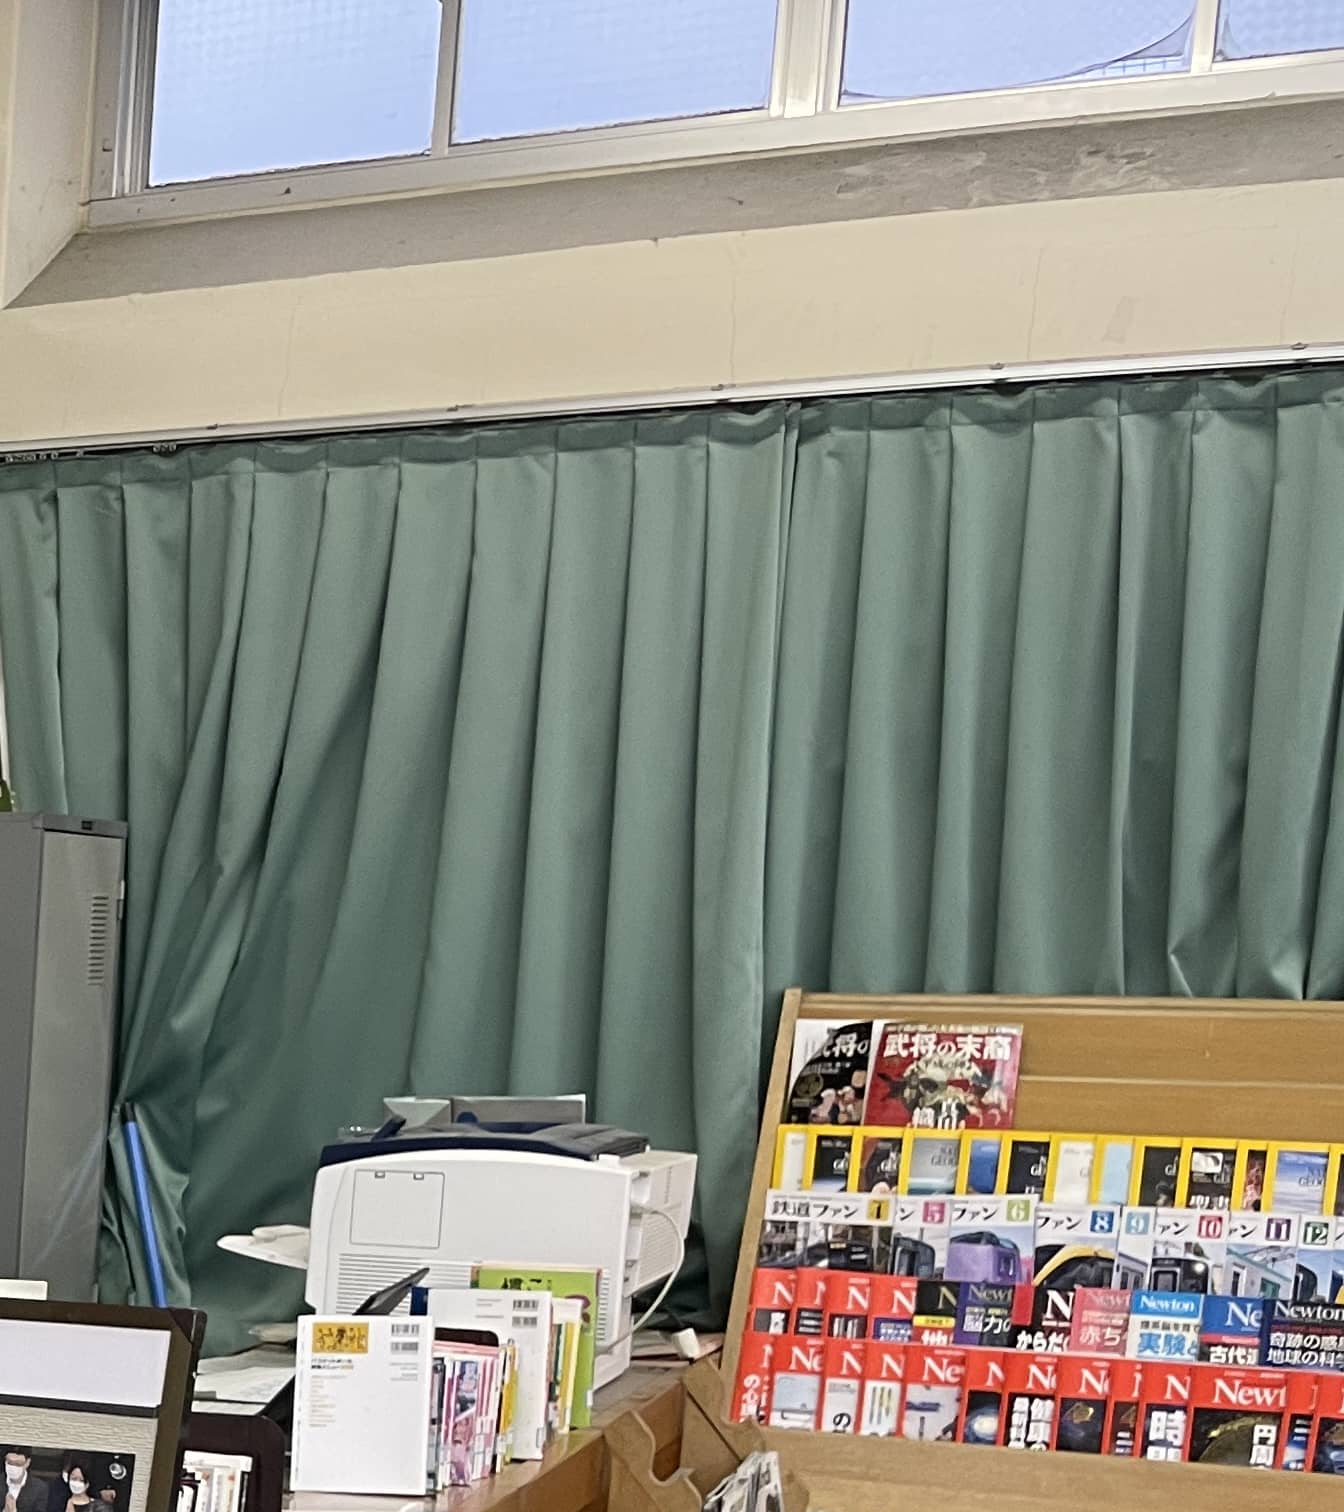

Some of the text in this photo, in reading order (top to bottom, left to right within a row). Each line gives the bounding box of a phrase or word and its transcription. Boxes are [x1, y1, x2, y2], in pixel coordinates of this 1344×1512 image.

[882, 1032, 1013, 1061] 武将の末裔
[770, 1200, 858, 1222] 鉄道ファン
[924, 1203, 942, 1222] 5
[1008, 1201, 1025, 1221] 6
[1093, 1213, 1111, 1232] 8
[1129, 1212, 1145, 1233] 9
[1198, 1217, 1222, 1238] 10
[1267, 1219, 1289, 1240] 11
[1303, 1223, 1327, 1244] 12
[1140, 1295, 1195, 1312] Newton
[1273, 1300, 1344, 1321] Newton
[1214, 1378, 1287, 1408] Newt
